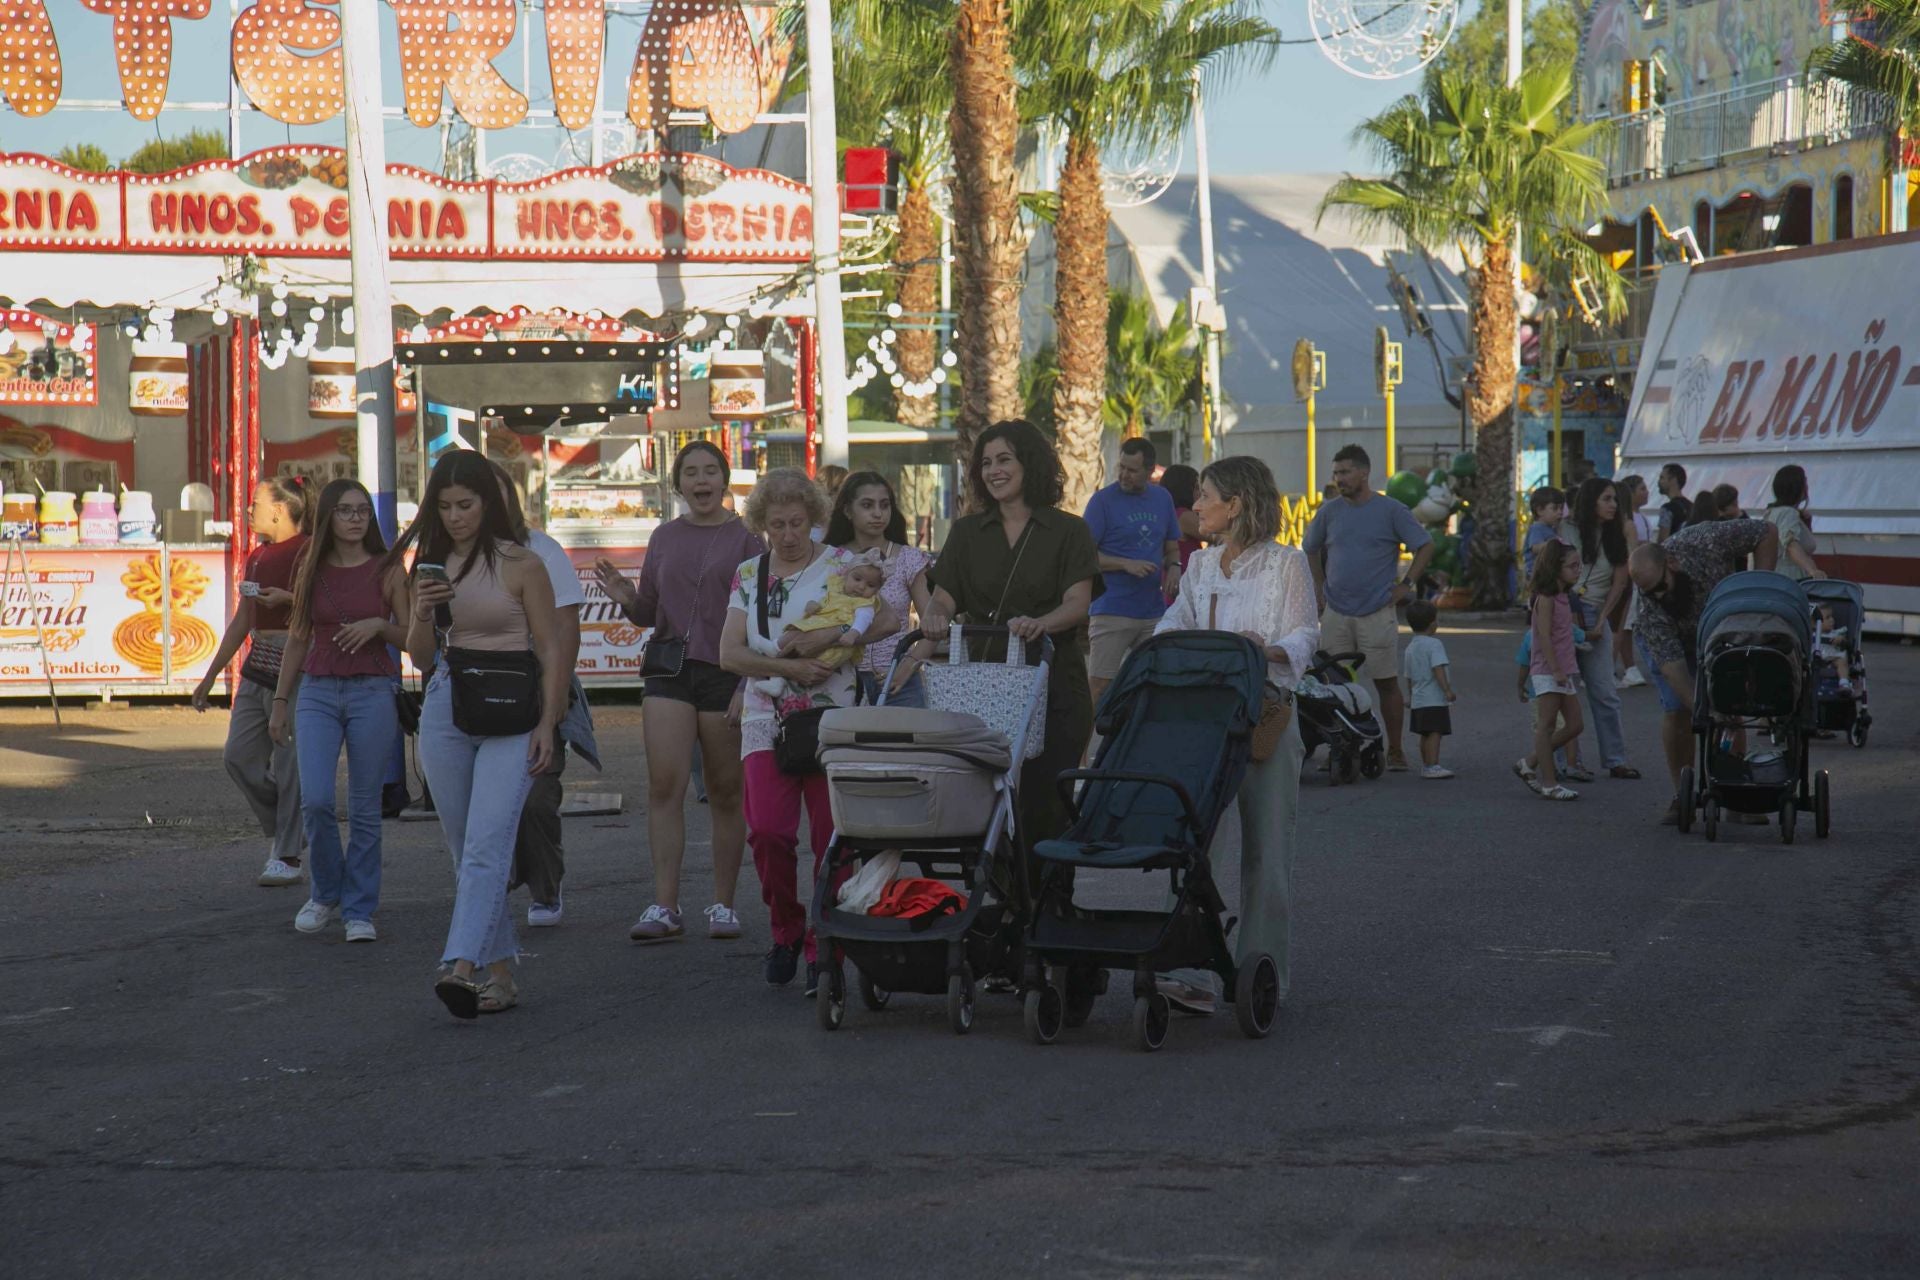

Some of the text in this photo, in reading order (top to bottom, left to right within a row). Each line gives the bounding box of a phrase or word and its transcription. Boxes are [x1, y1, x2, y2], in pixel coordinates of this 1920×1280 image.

[150, 192, 466, 240] HNOS. PENIA
[517, 199, 633, 241] HNOS.
[1699, 318, 1902, 443] EL MAÑO
